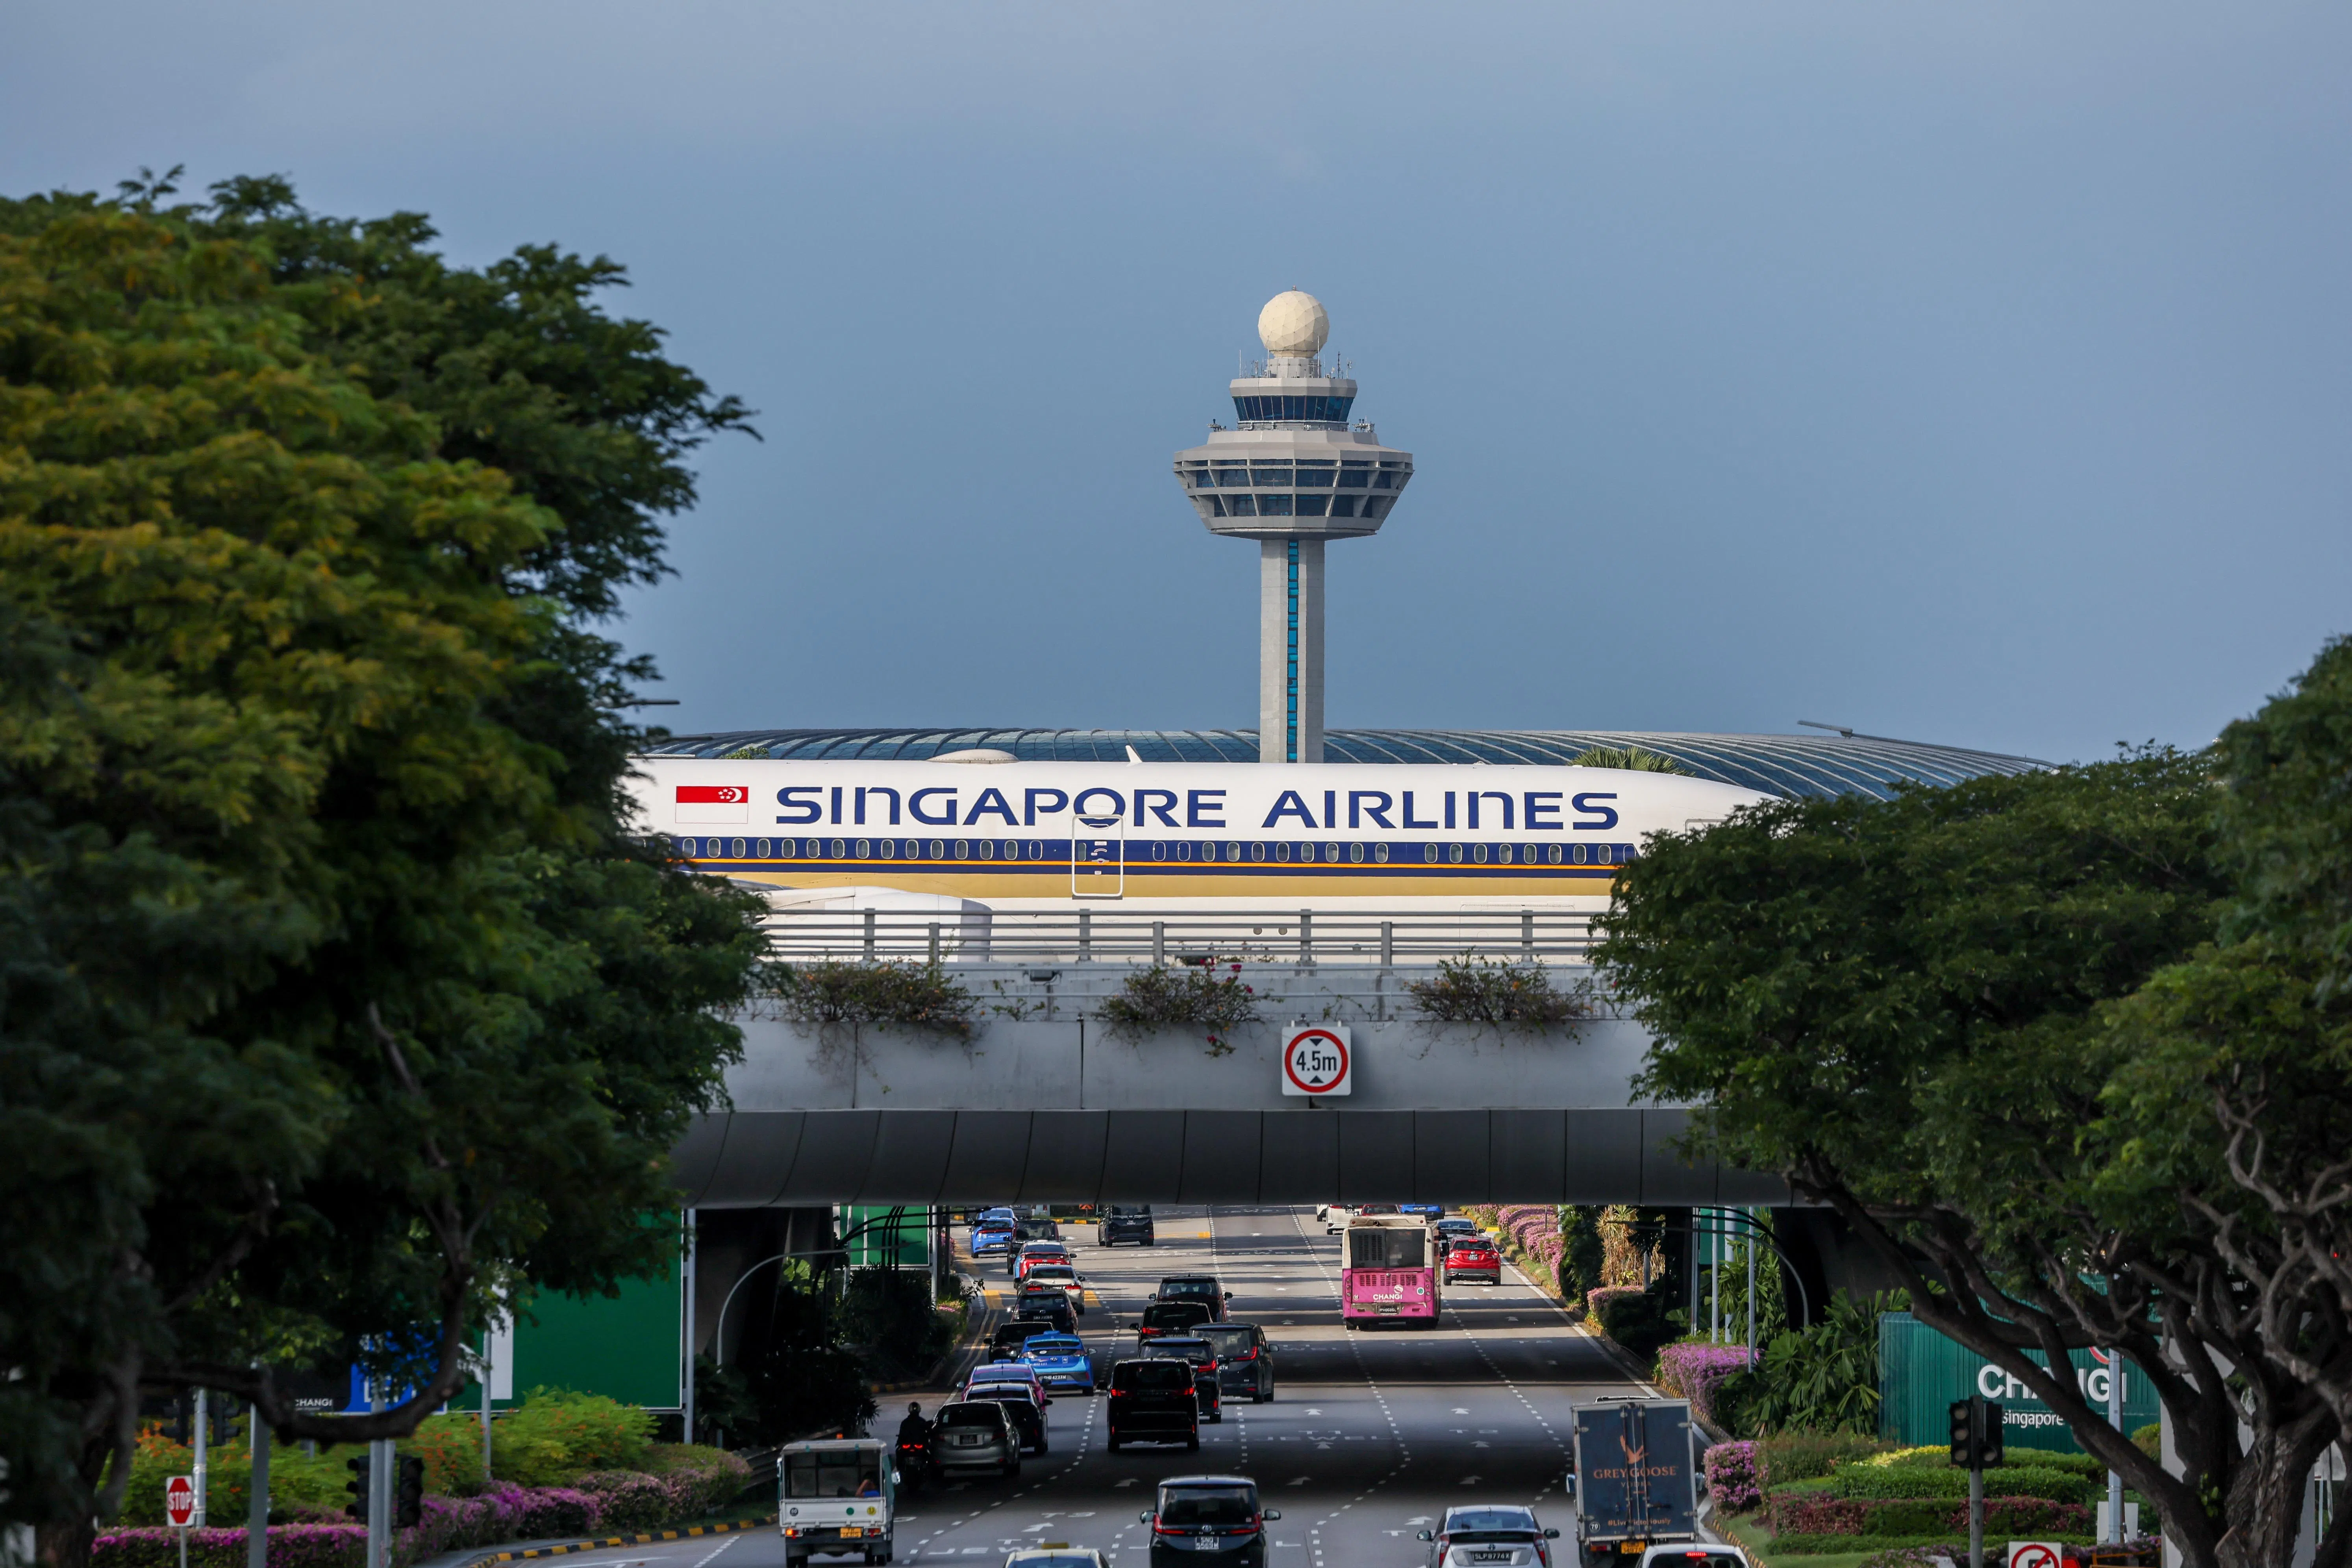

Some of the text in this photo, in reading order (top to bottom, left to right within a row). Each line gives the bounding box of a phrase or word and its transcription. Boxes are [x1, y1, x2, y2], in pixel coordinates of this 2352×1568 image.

[776, 787, 1619, 830] SINGAPORE AIRLINES
[1296, 1051, 1337, 1071] 4.5m
[2002, 1410, 2065, 1429] singapore
[1594, 1466, 1676, 1479] GREY GOOSE
[169, 1492, 192, 1510] STOP
